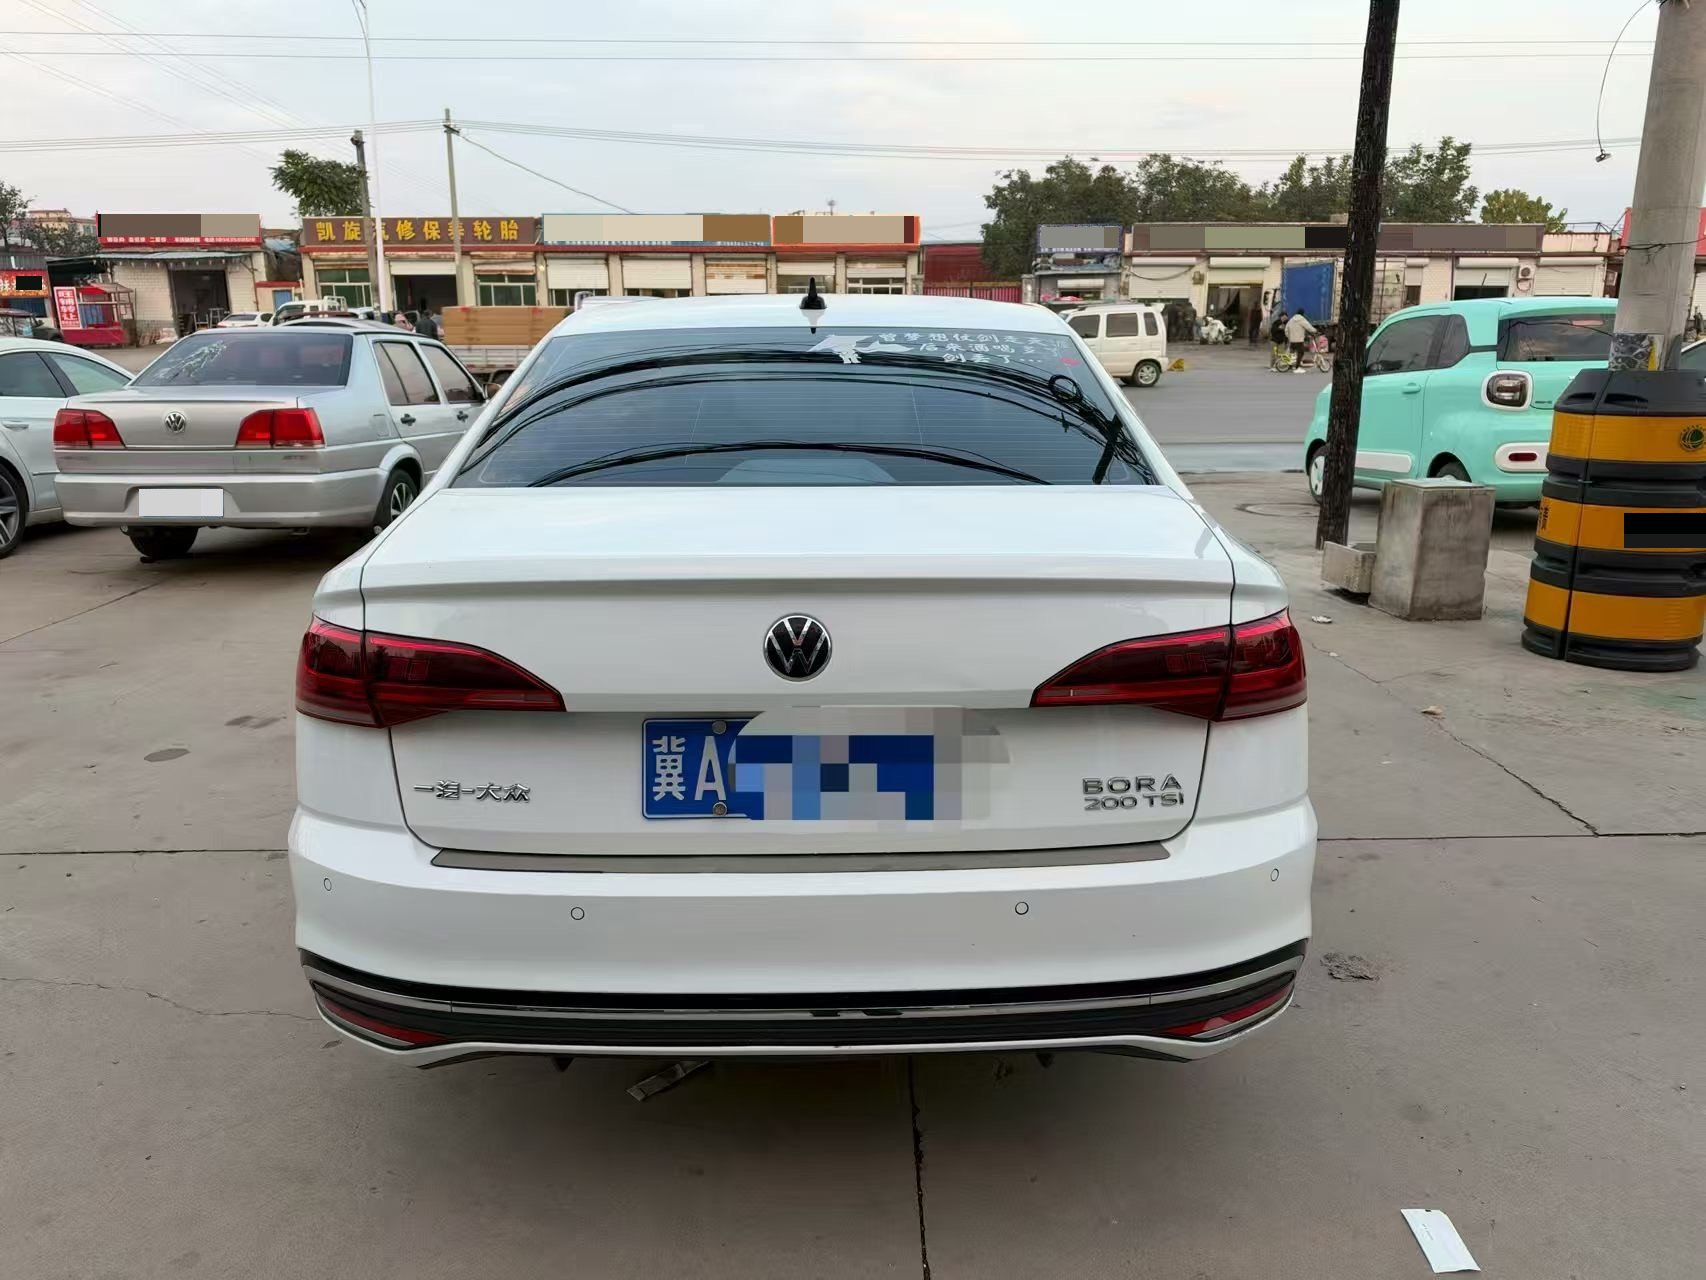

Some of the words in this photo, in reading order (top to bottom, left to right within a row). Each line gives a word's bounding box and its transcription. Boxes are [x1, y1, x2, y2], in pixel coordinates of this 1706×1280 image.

[1082, 773, 1182, 795] BORA
[1084, 795, 1138, 811] 200
[1142, 792, 1185, 808] TSI
